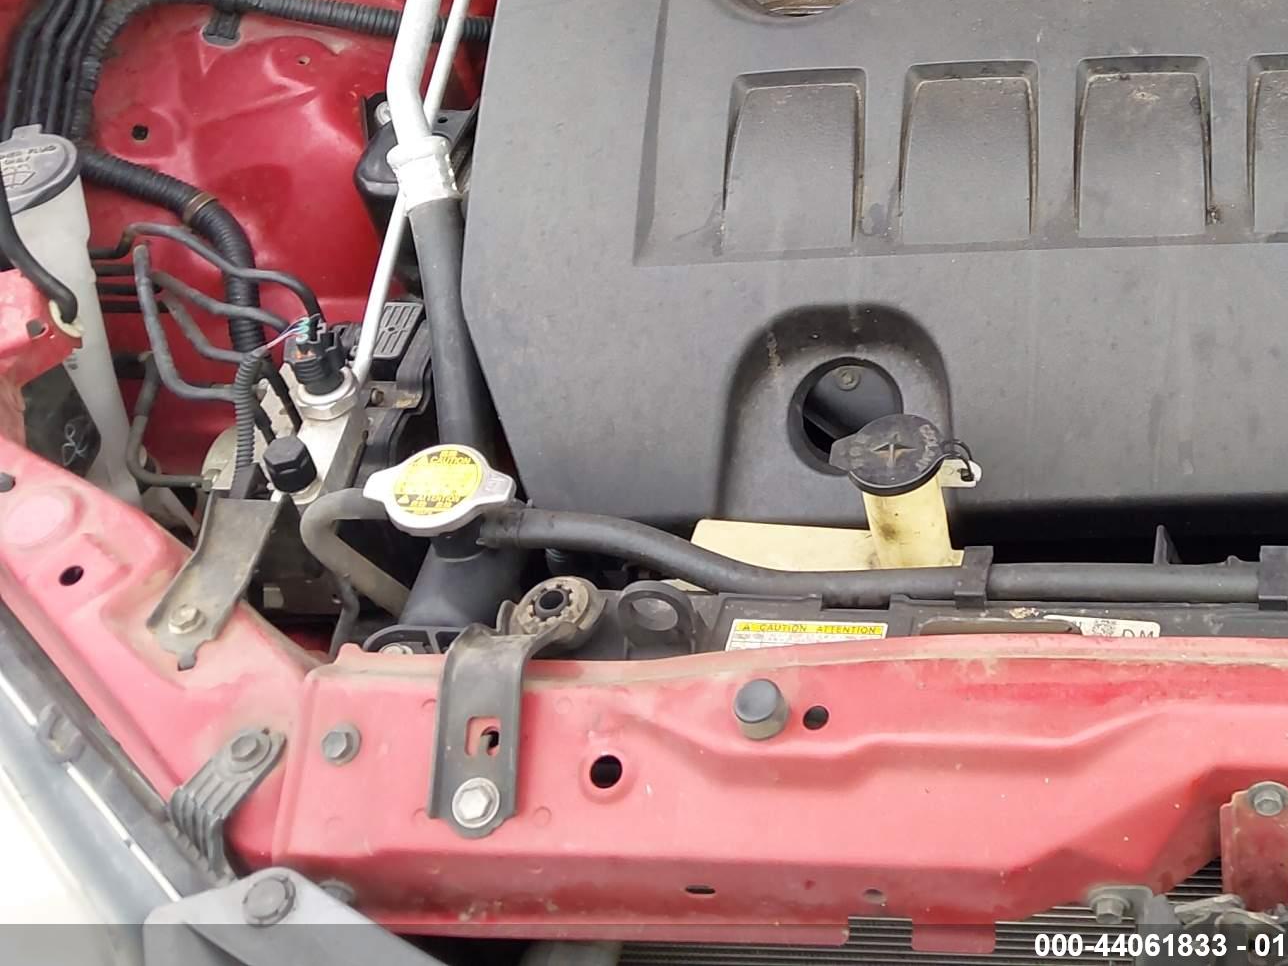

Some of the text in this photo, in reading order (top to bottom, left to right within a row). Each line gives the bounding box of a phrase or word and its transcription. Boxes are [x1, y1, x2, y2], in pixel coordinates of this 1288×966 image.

[429, 456, 472, 465] CAUTION
[759, 623, 877, 635] CAUTION ATTENTION
